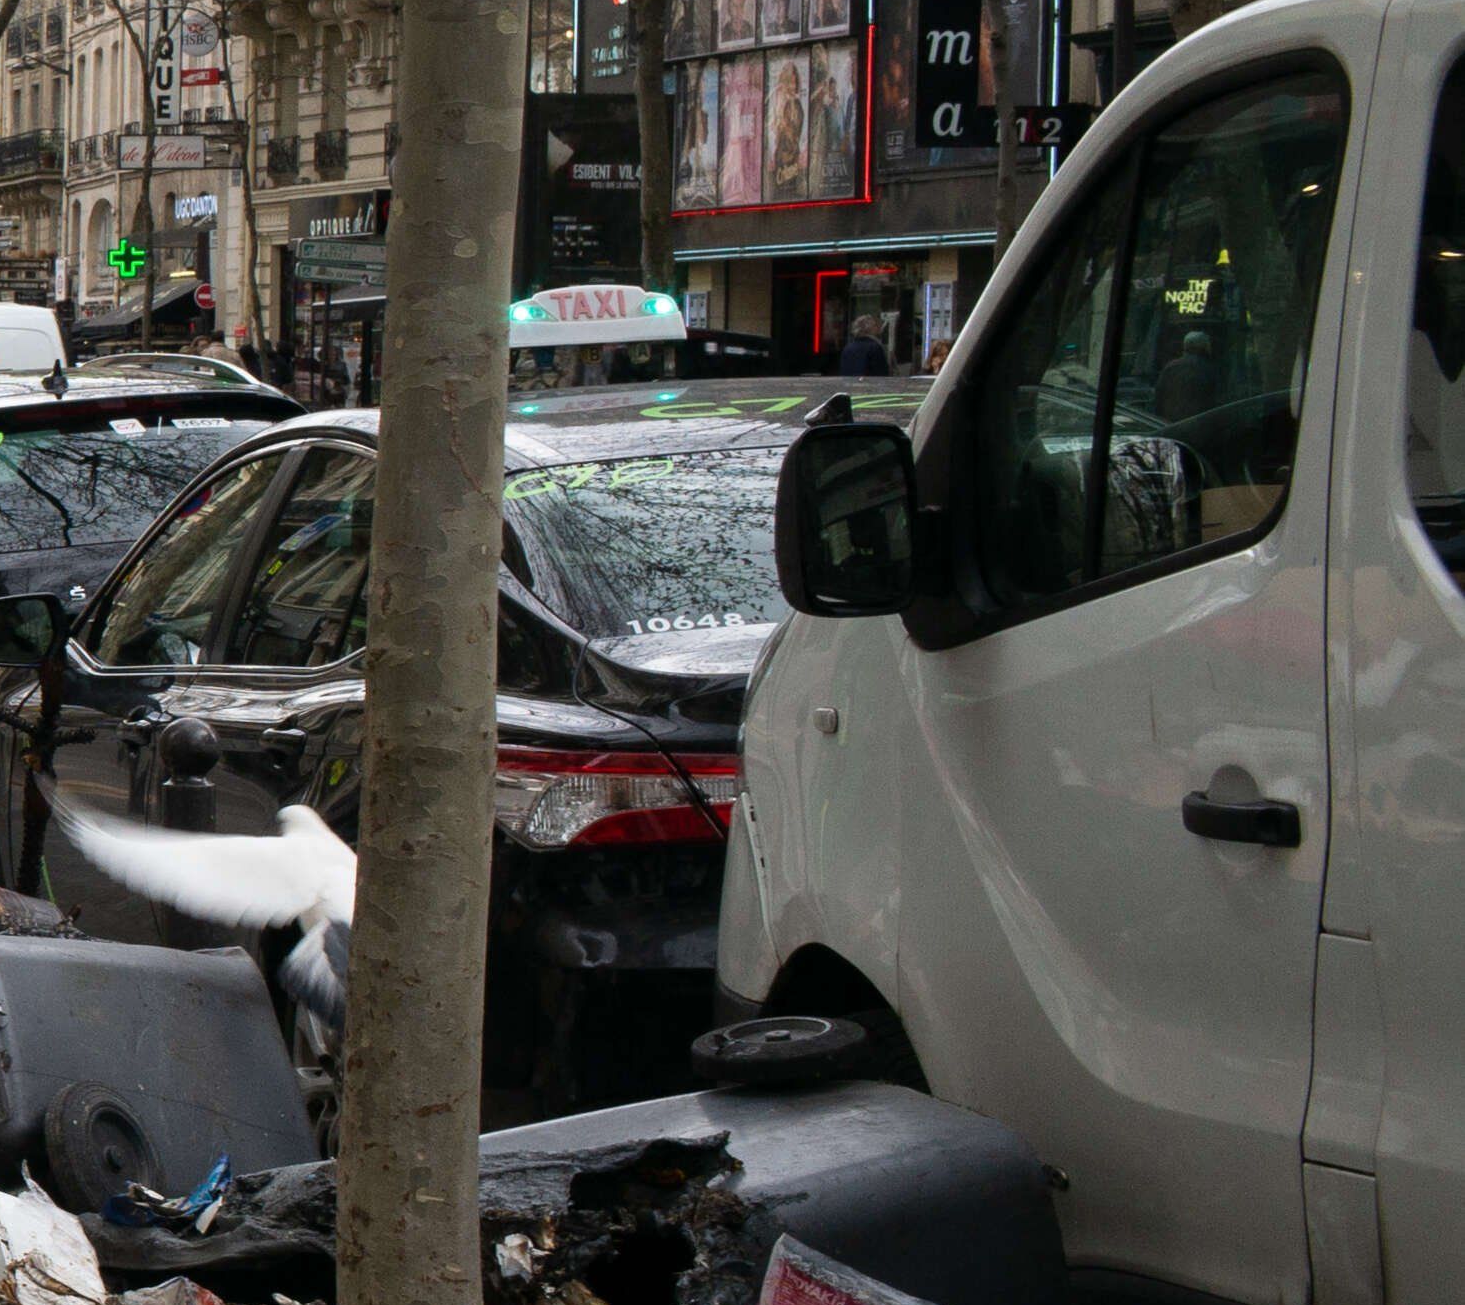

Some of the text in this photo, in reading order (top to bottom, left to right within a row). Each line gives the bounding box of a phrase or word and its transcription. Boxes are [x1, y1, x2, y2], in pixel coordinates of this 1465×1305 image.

[309, 218, 351, 236] OPTIQUE
[550, 289, 627, 322] TAXI
[1179, 302, 1205, 314] FAC
[626, 612, 746, 635] 10648
